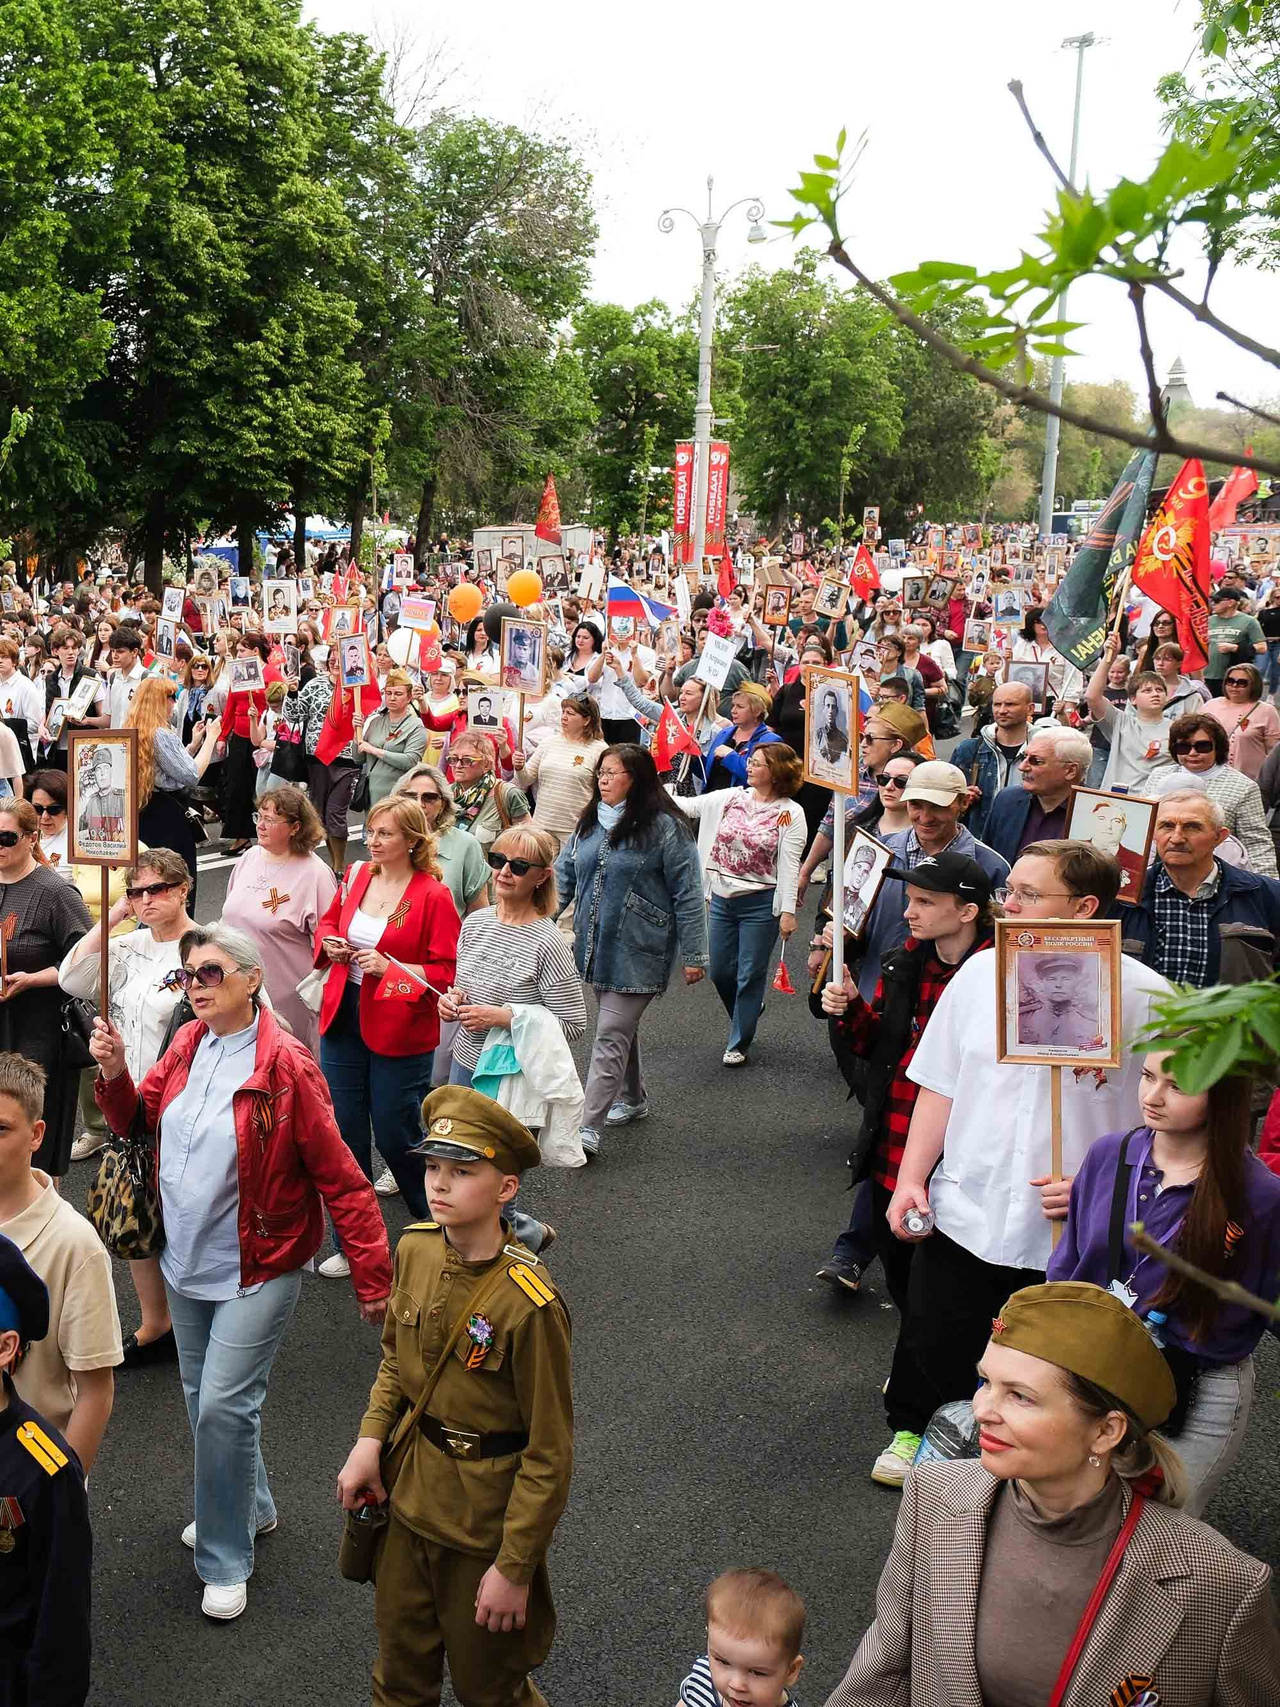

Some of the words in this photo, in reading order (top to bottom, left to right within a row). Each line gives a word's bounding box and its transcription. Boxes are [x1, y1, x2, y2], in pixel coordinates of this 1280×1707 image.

[676, 471, 687, 525] ПОБЕДА!
[708, 470, 719, 523] ПОБЕДА!
[102, 840, 127, 849] Василий
